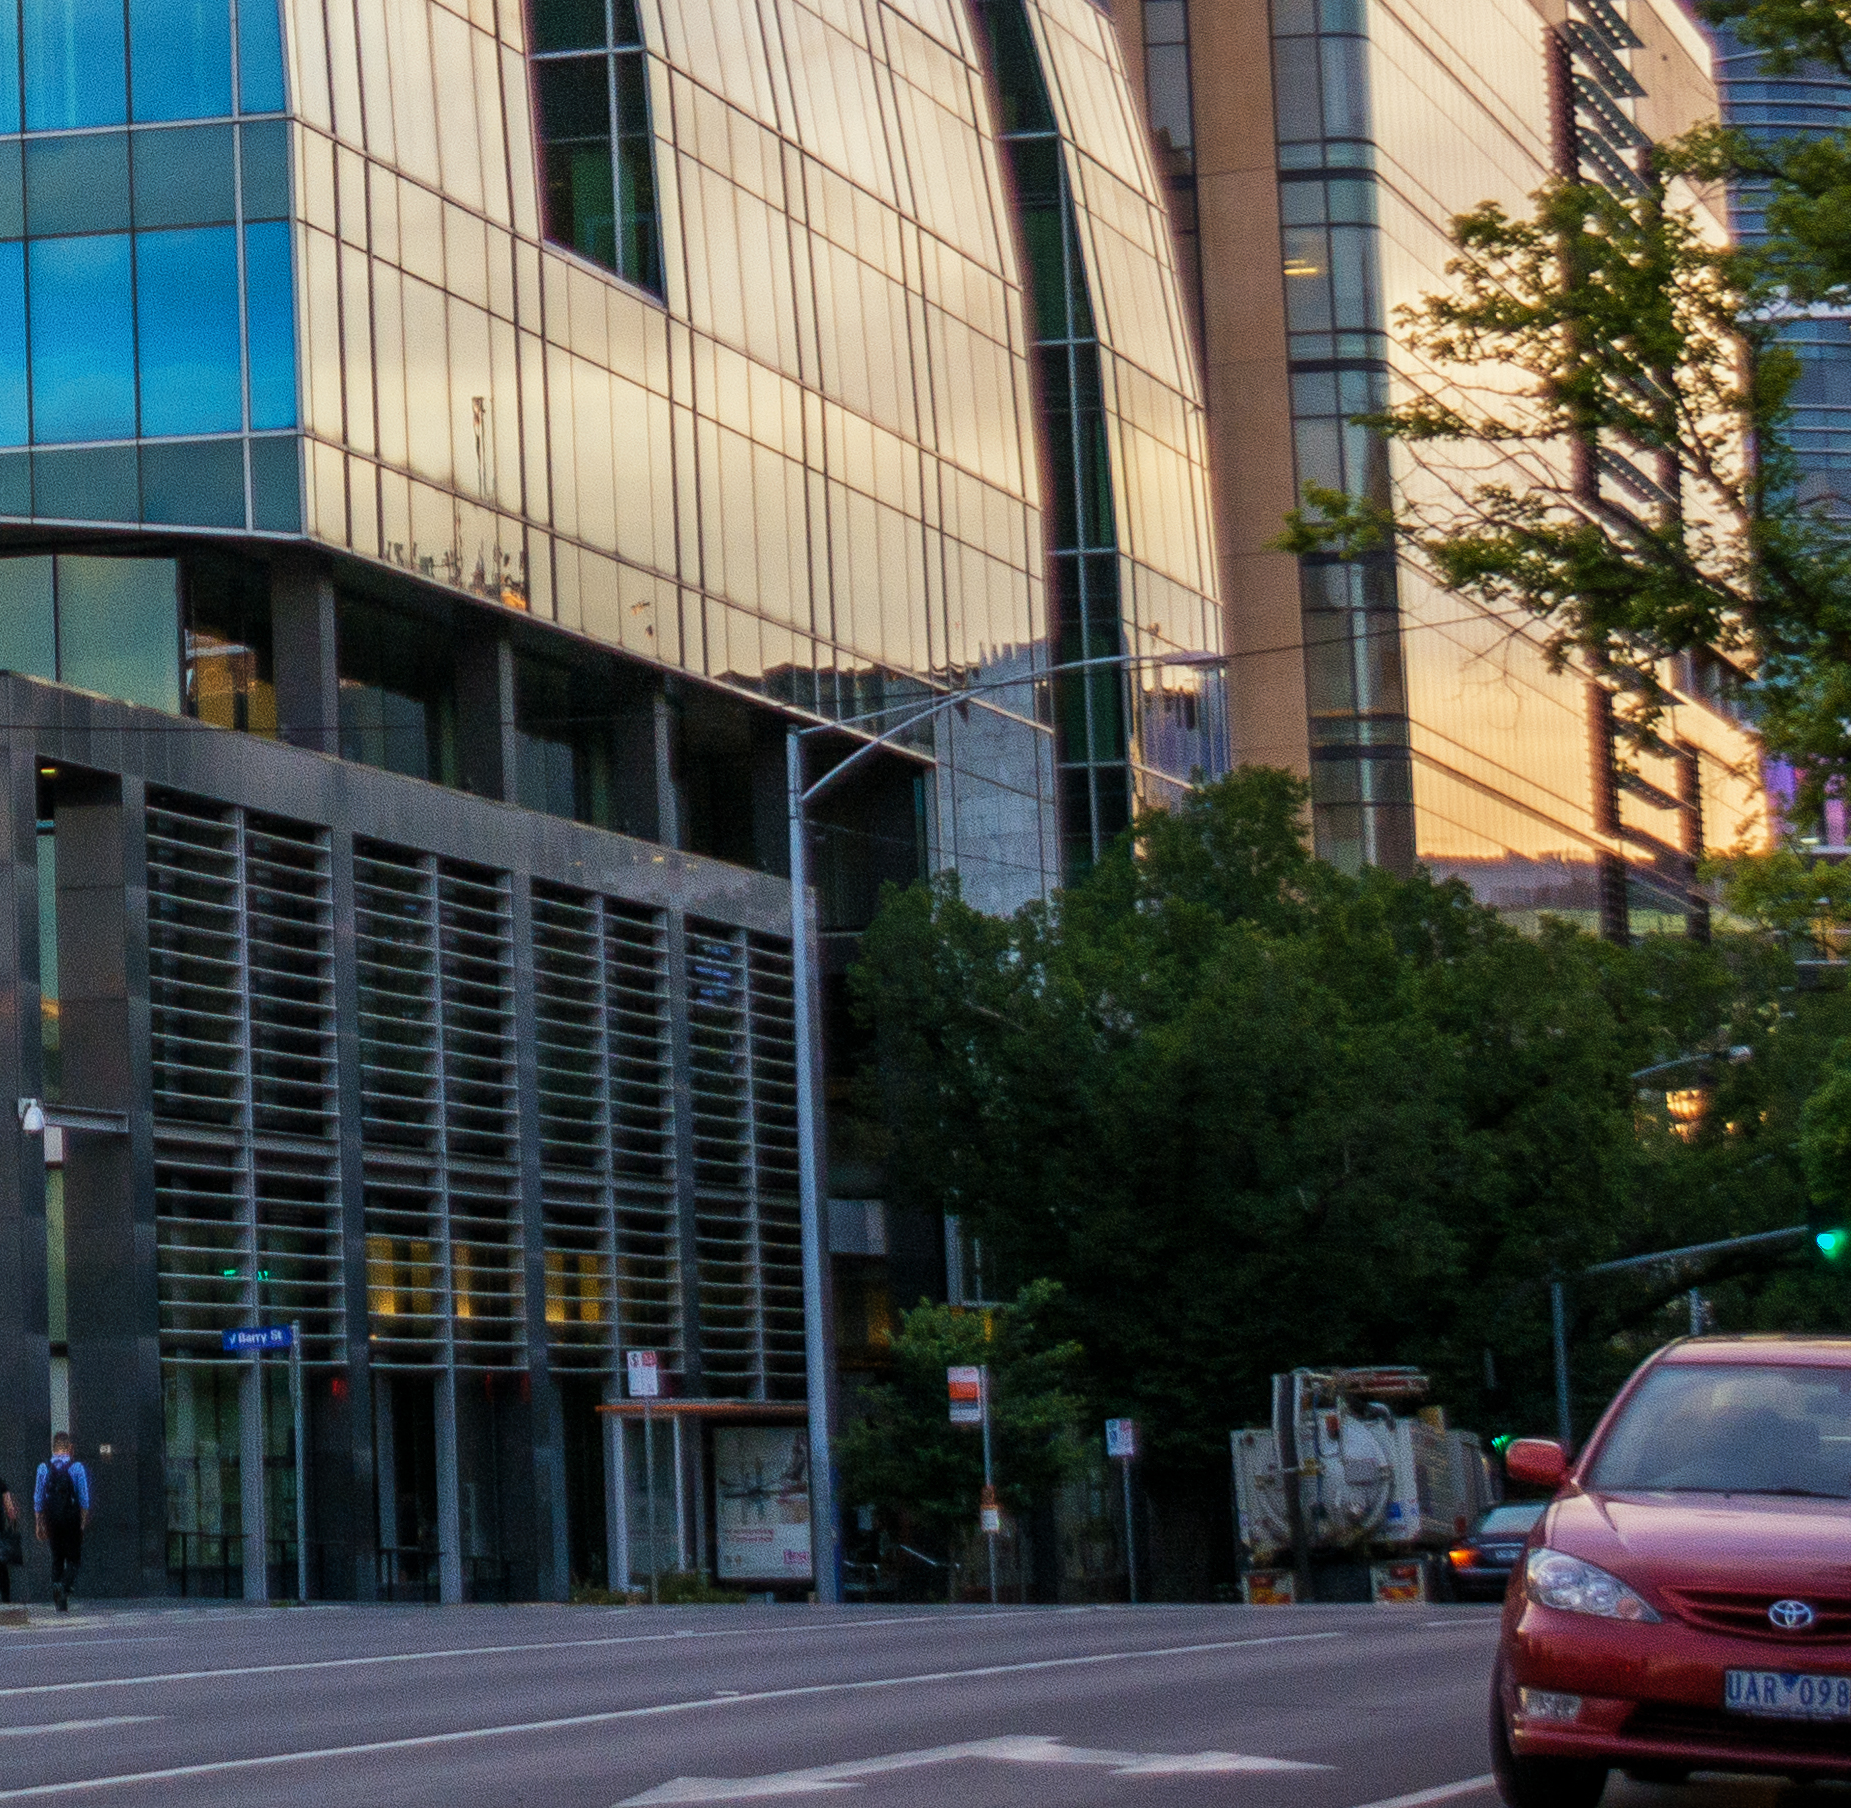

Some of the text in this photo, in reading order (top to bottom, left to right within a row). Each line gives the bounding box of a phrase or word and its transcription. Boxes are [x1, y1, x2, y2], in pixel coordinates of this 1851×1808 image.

[238, 1331, 267, 1345] Barry
[1727, 1673, 1850, 1708] UAR 098
